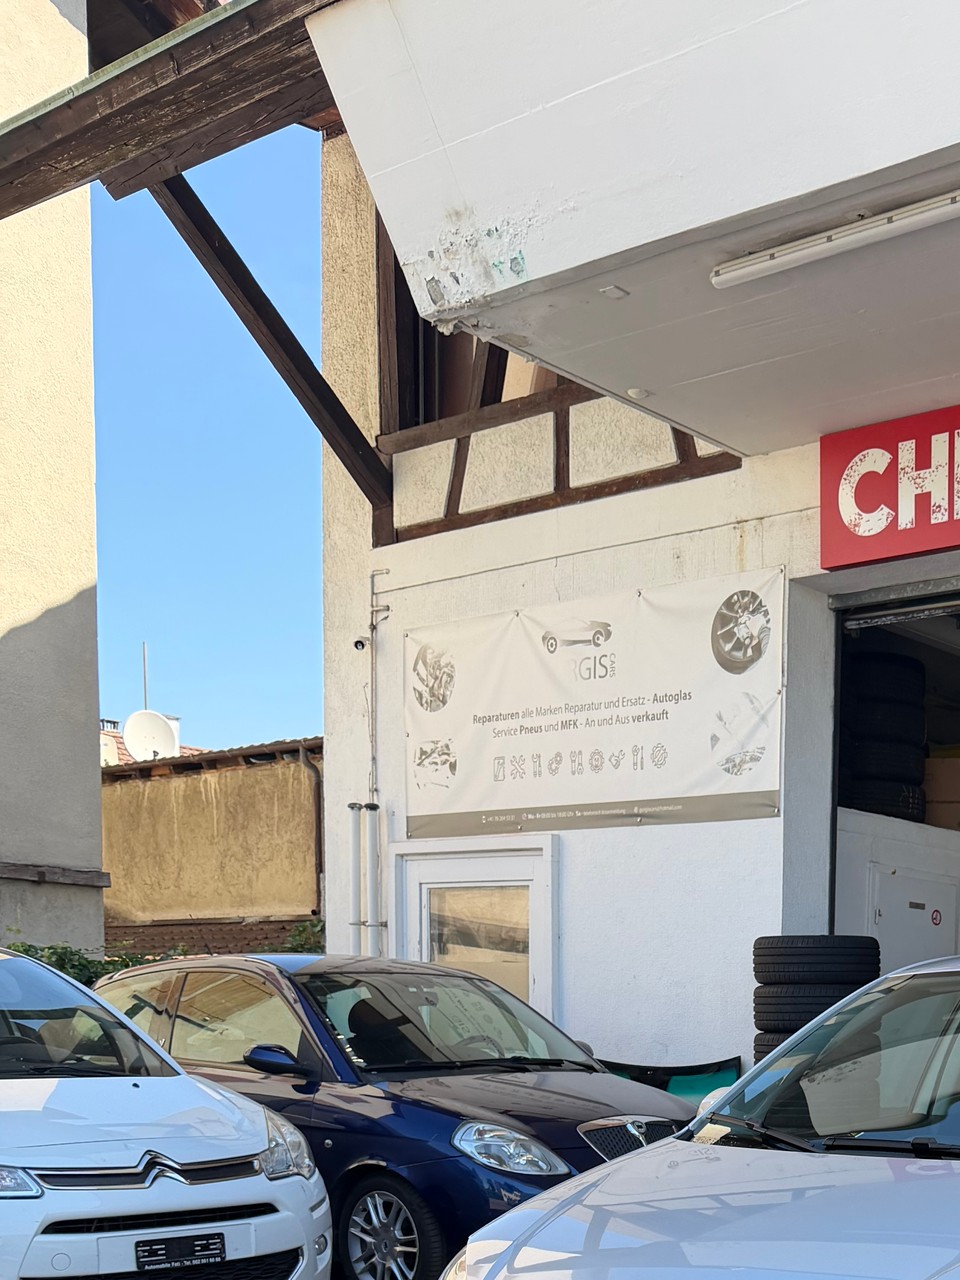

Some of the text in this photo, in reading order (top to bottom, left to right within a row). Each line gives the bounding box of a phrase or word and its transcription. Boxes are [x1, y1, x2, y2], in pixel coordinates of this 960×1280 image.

[472, 711, 520, 726] Reparaturen
[521, 708, 534, 719] alle
[535, 705, 563, 717] Marken
[564, 701, 602, 715] Reparatur
[604, 697, 620, 709] und
[621, 696, 646, 708] Ersatz
[652, 690, 692, 705] Autoglas
[492, 727, 518, 738] Service
[519, 724, 543, 735] Pneus
[544, 721, 559, 732] und
[560, 719, 579, 731] MFK
[584, 718, 596, 728] An
[597, 715, 613, 727] und
[615, 714, 630, 725] Aus
[631, 709, 669, 723] verkauft
